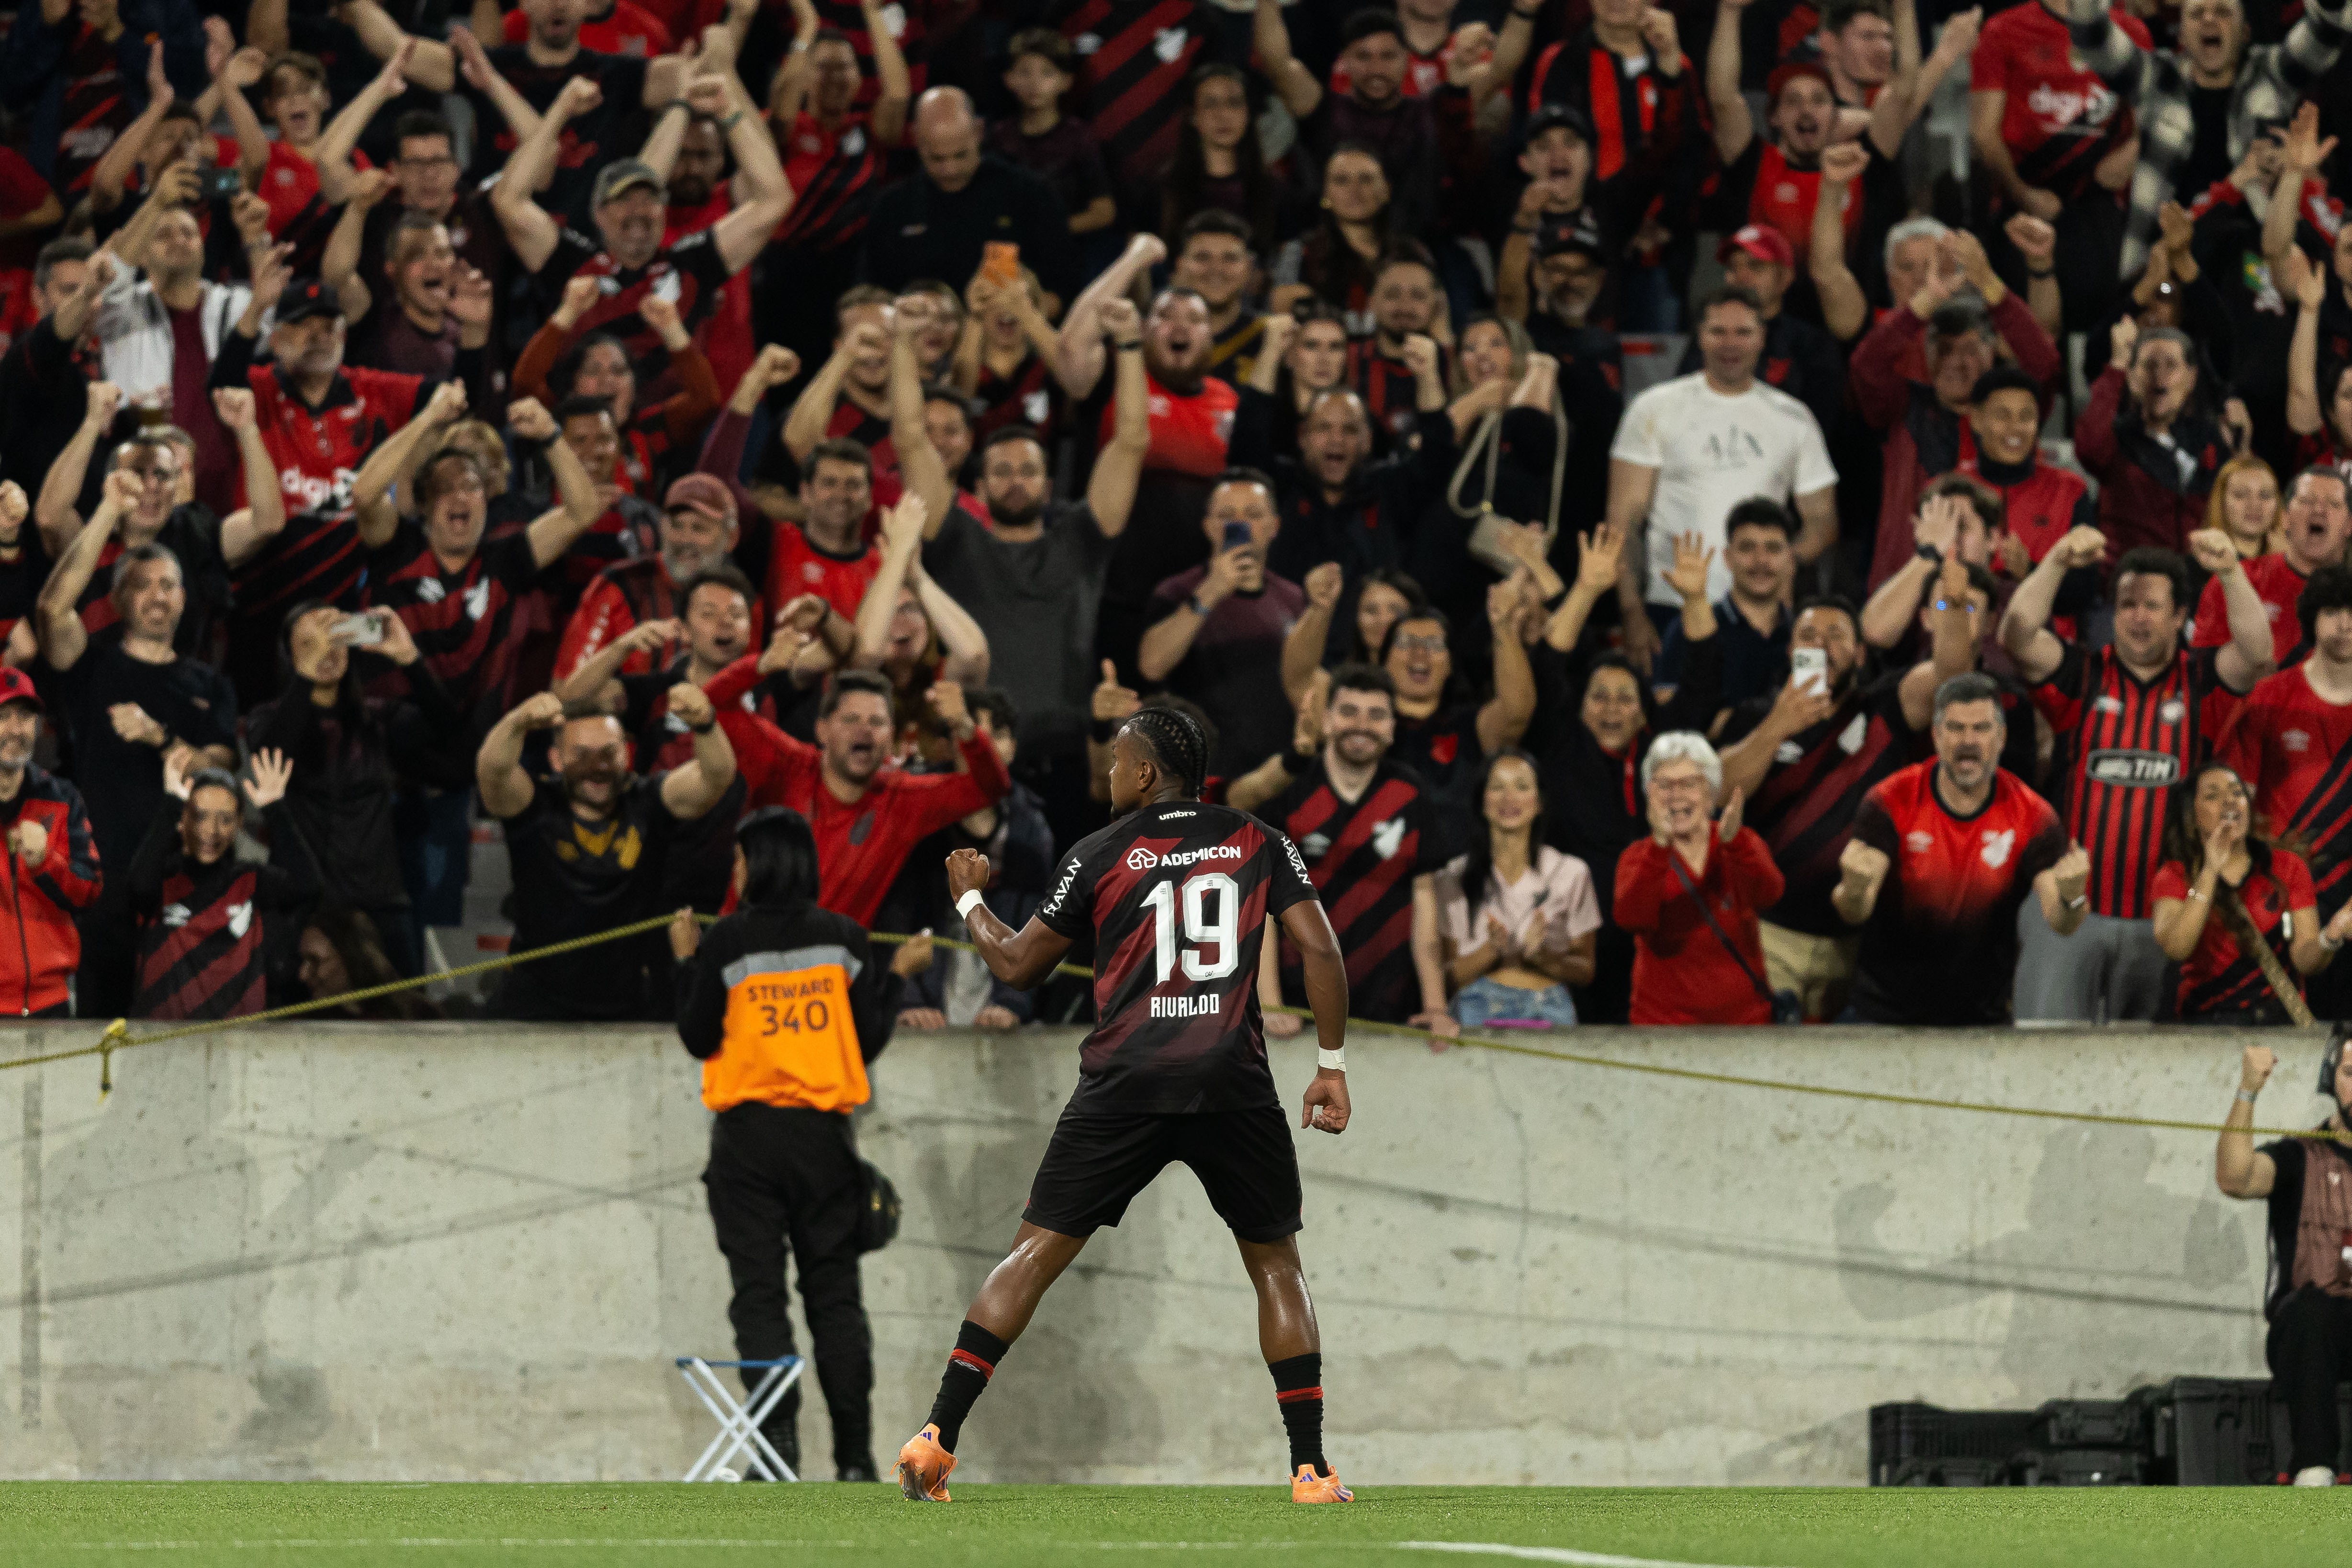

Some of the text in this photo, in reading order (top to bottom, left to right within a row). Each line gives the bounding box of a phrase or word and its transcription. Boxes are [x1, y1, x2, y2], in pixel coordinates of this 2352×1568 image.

[1159, 811, 1197, 820] umbro
[1160, 846, 1241, 867] ADEMICON
[1043, 857, 1082, 917] HAVAN
[1140, 872, 1239, 986] 19
[748, 979, 833, 1001] STEWARD
[1151, 993, 1219, 1017] RIVALDO
[761, 1000, 829, 1036] 340
